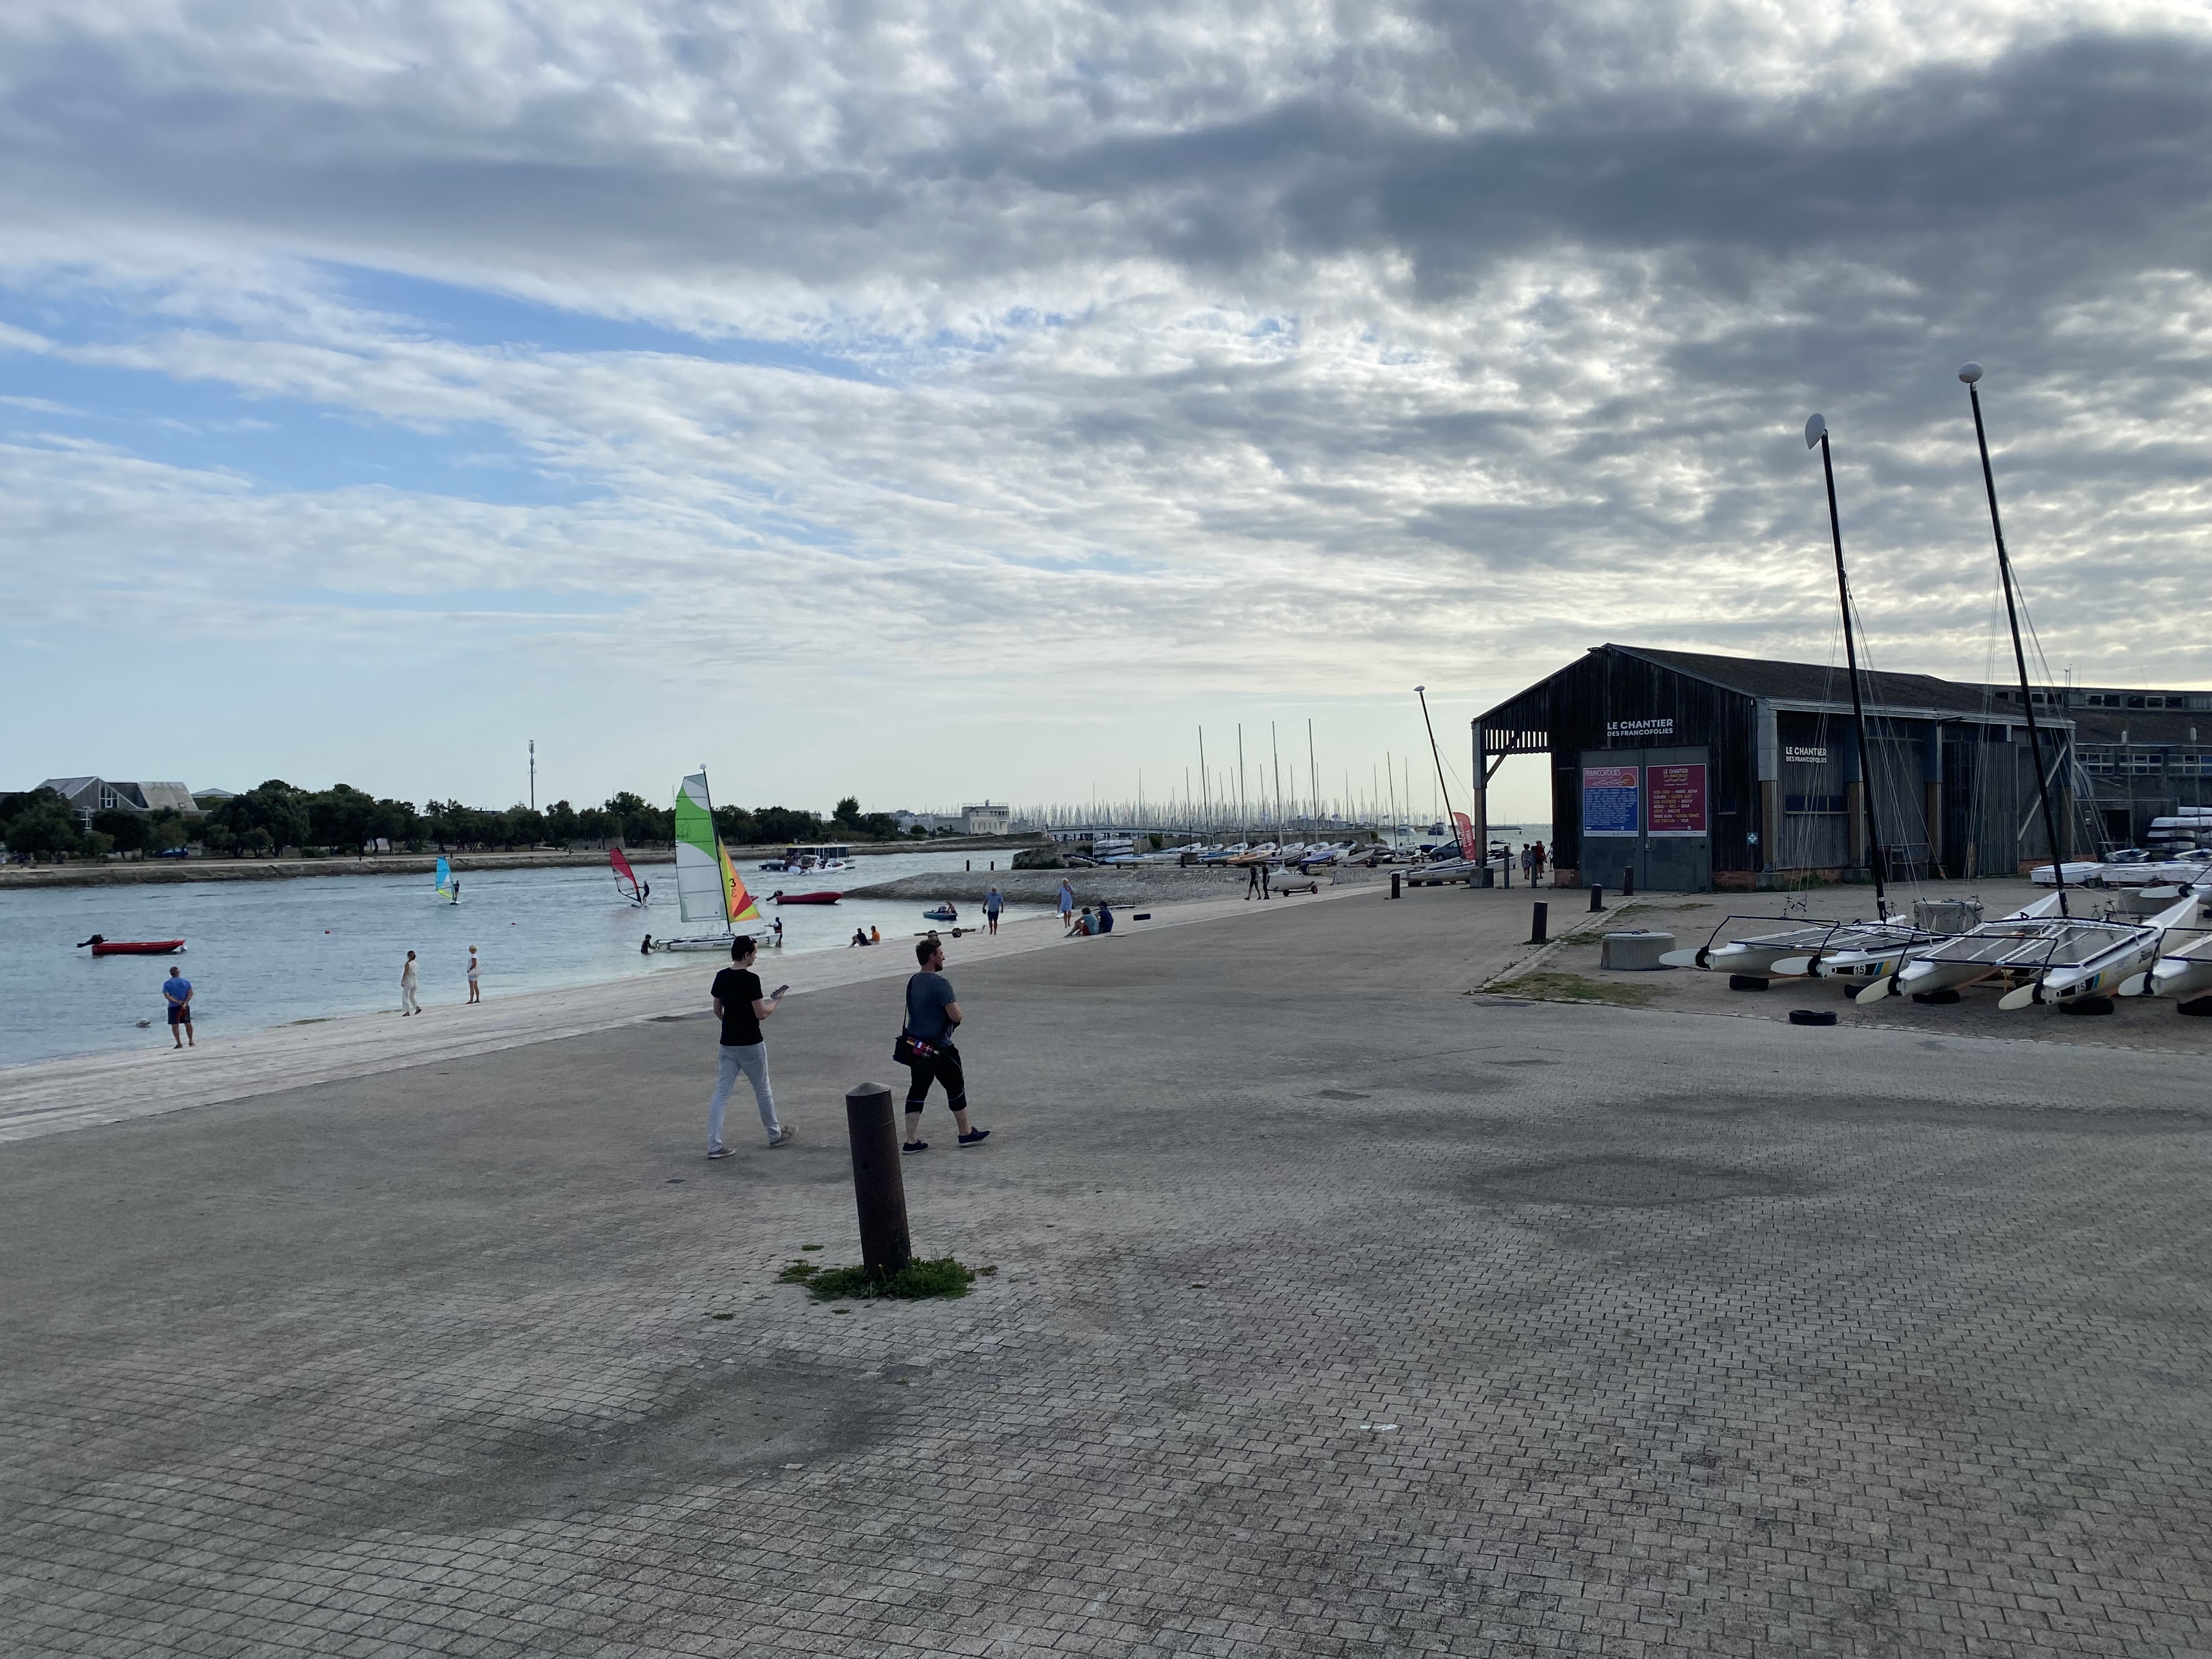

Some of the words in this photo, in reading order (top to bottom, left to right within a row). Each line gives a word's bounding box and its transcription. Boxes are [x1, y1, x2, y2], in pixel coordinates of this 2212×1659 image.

[1607, 722, 1618, 730] LE
[1620, 719, 1673, 729] CHANTIER
[1786, 747, 1793, 755] LE
[1795, 747, 1827, 756] CHANTIER
[729, 878, 736, 888] 3
[1855, 966, 1865, 975] 15
[2076, 982, 2085, 992] 15
